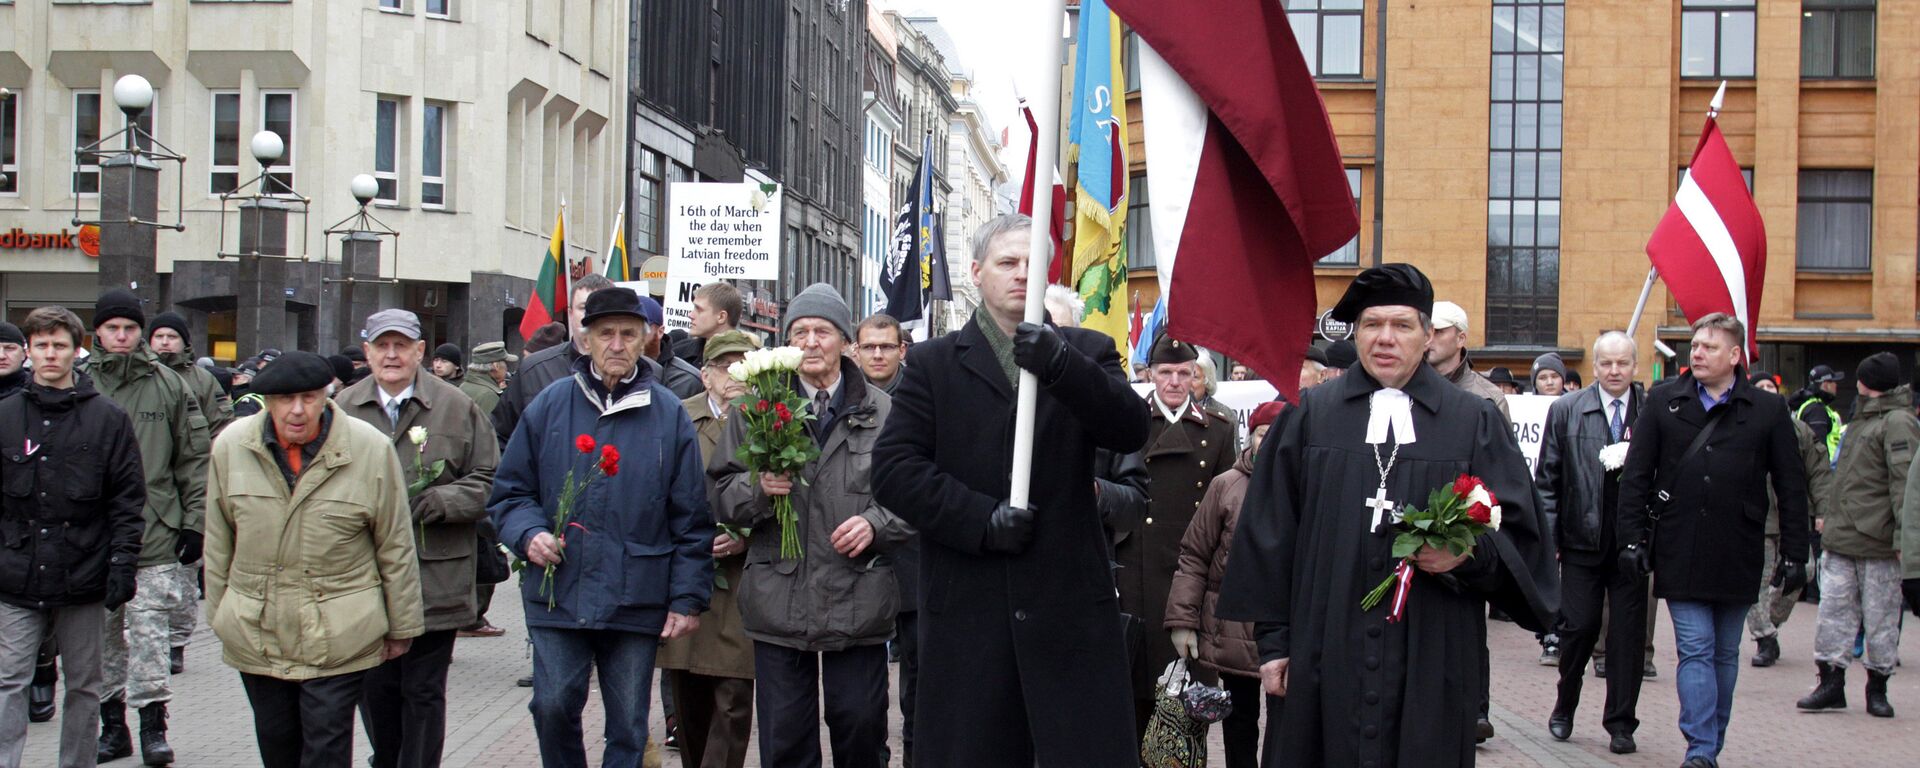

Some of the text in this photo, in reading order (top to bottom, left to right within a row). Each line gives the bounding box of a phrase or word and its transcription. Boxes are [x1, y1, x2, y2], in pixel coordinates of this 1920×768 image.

[680, 205, 706, 217] 16th
[710, 205, 721, 217] of
[725, 205, 759, 218] March
[689, 219, 762, 234] the day when
[0, 228, 76, 250] dbank
[688, 234, 762, 246] we remember
[681, 247, 769, 260] Latvian freedom
[704, 261, 745, 276] fighters
[666, 307, 674, 316] TO
